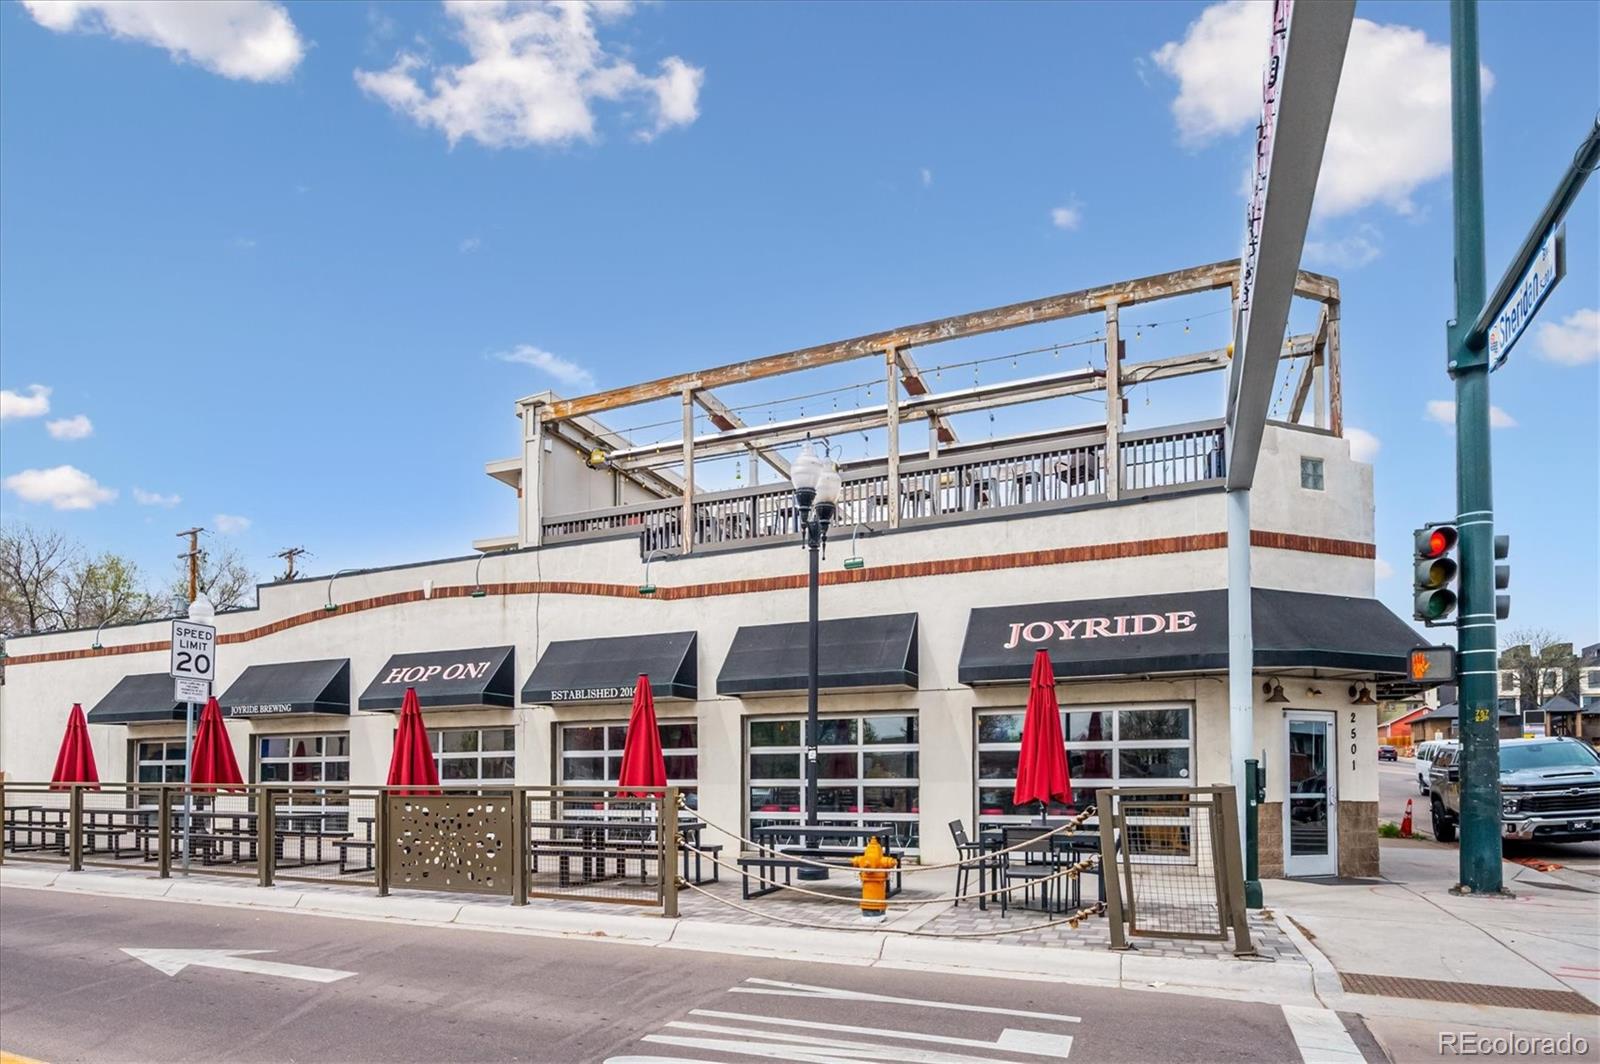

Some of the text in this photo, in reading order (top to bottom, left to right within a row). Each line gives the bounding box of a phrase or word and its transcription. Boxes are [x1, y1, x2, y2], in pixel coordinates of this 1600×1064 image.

[1499, 272, 1539, 348] Sheridan
[176, 627, 213, 641] SPEED
[1003, 610, 1197, 650] JOYRIDE
[179, 639, 208, 651] LIMIT
[176, 651, 211, 674] 20
[382, 661, 491, 684] HOP ON!
[551, 687, 619, 701] ESTABLISHED
[231, 703, 292, 717] JOYRIDE BREWING
